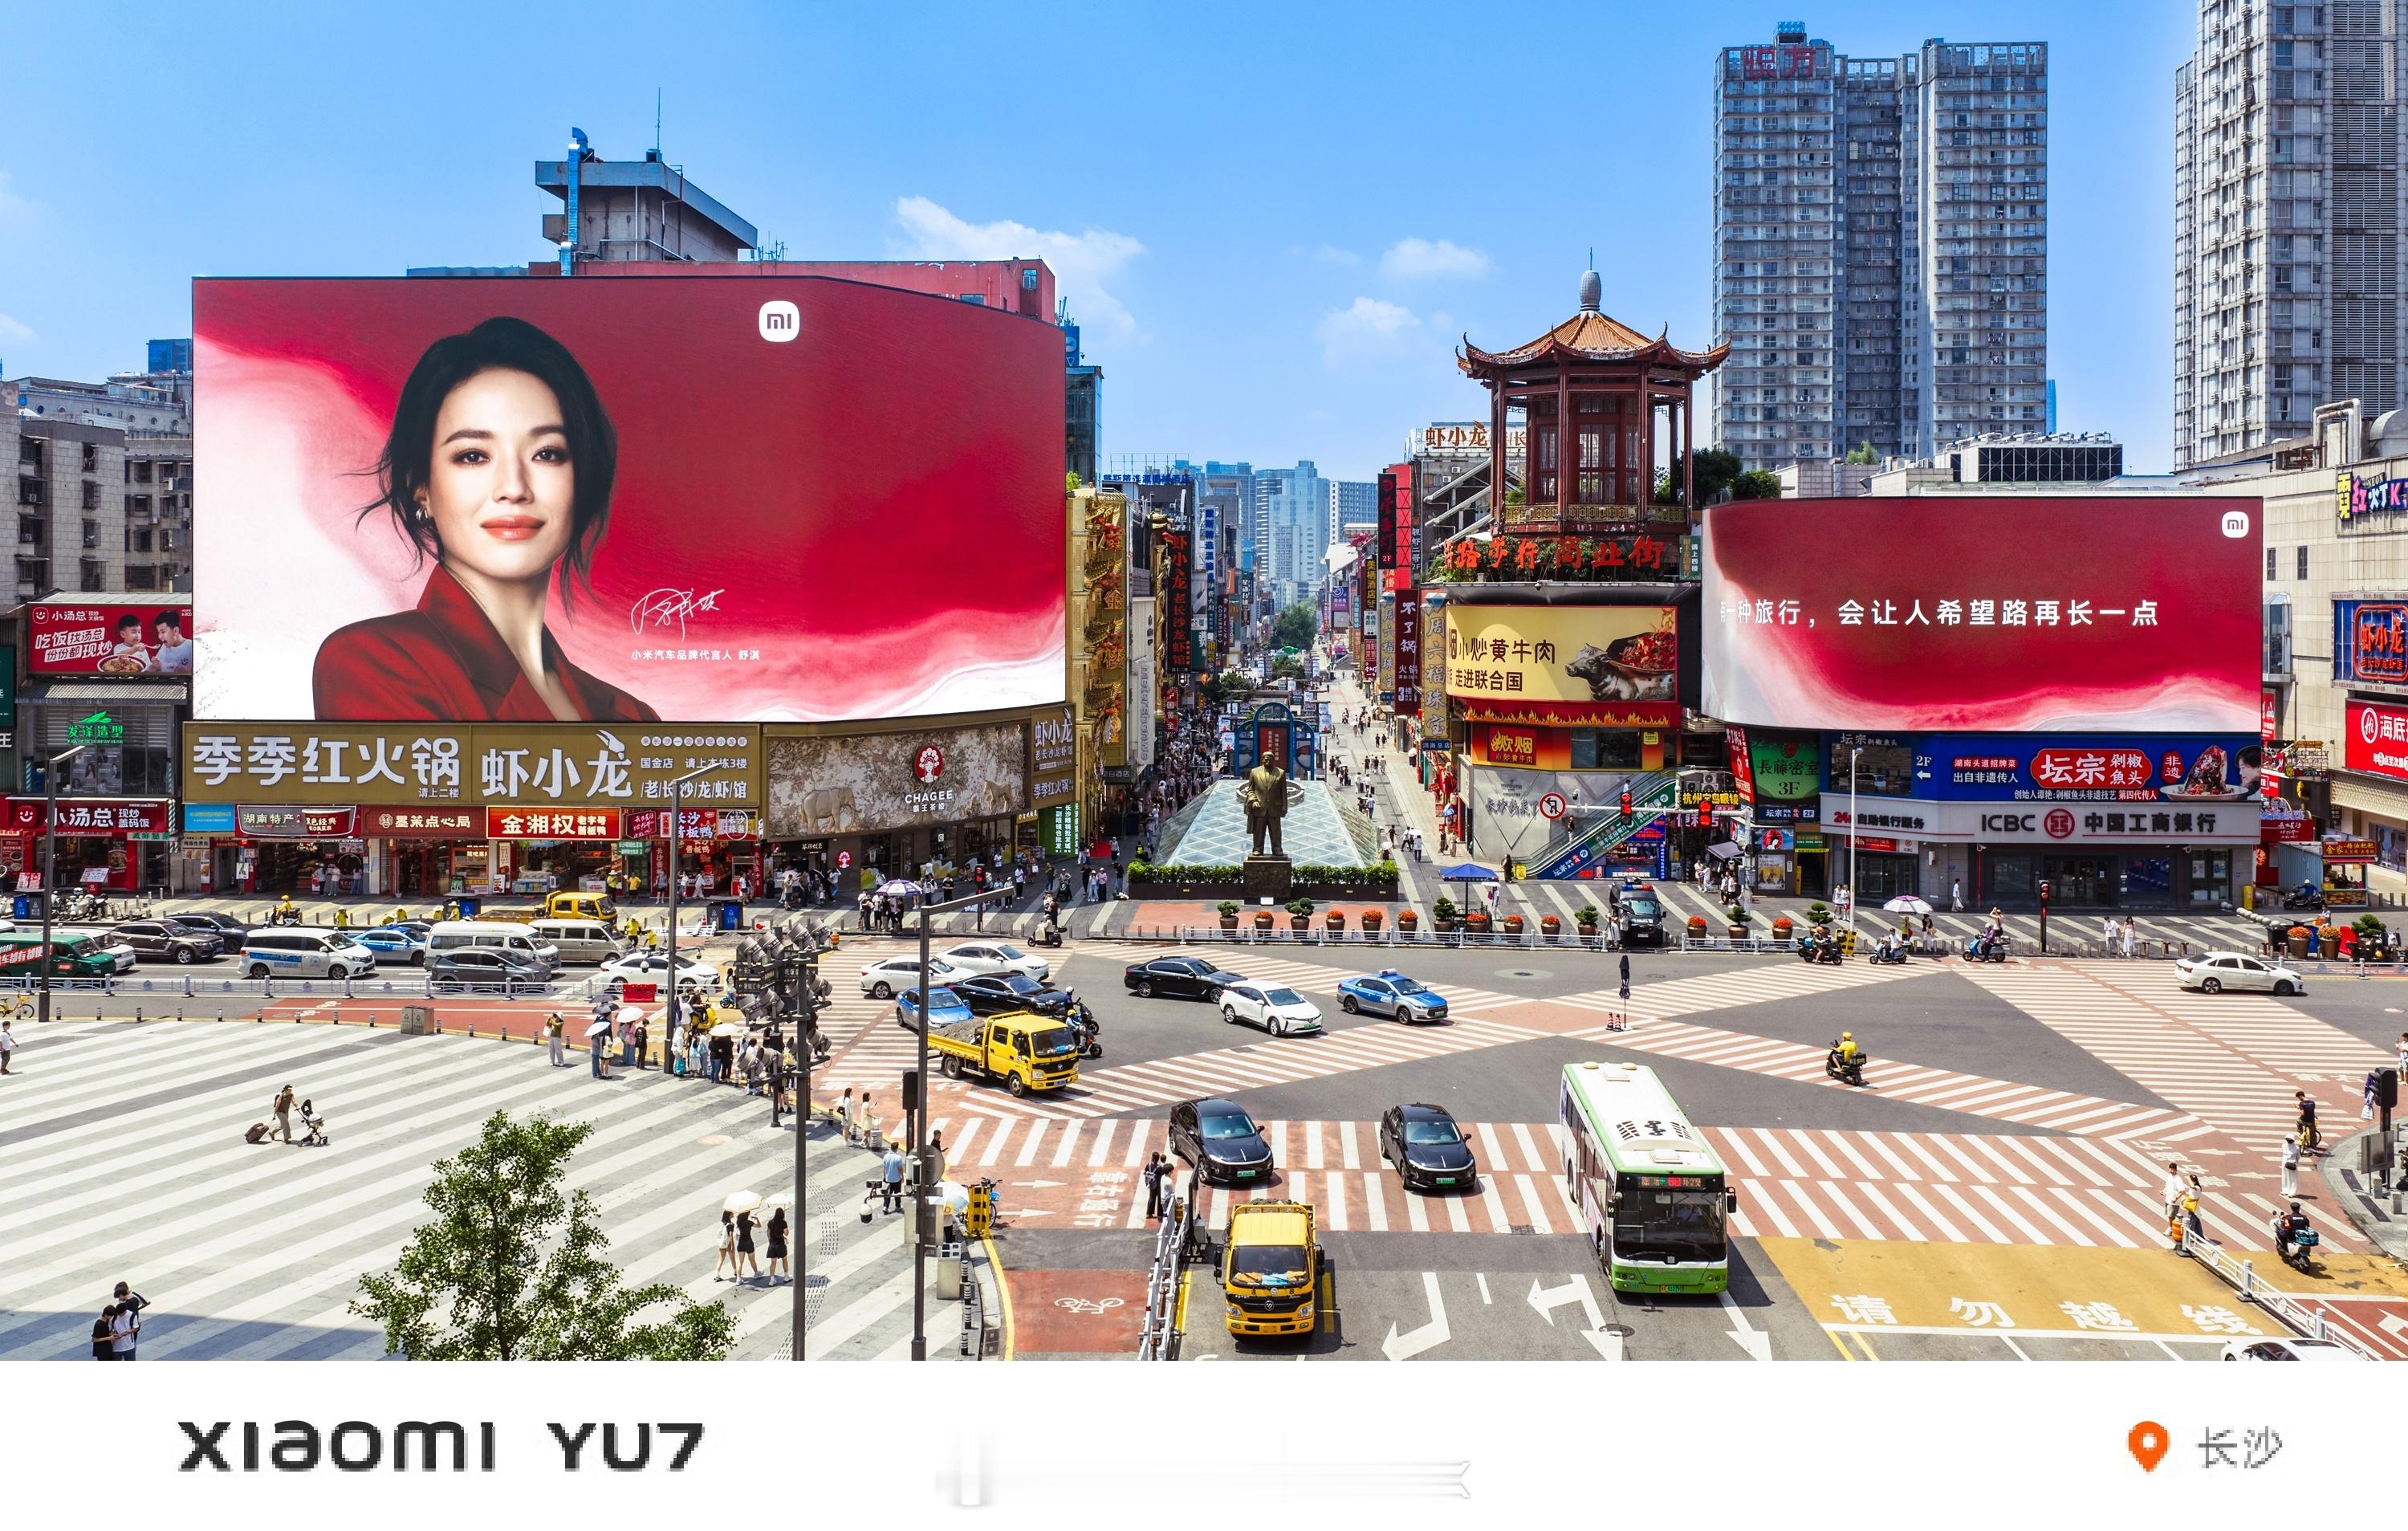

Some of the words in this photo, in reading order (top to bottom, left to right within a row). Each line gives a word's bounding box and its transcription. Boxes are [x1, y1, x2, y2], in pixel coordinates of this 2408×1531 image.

[1426, 420, 1487, 446] 虾小龙
[1171, 535, 1188, 589] 虾小龙
[52, 610, 87, 621] 小汤总
[1172, 592, 1186, 666] 老长沙龙虾馆
[1400, 601, 1417, 654] 不了锅
[2361, 613, 2404, 654] 虾小龙
[35, 627, 106, 649] 吃饭找汤总
[44, 639, 113, 663] 份份都现炒
[631, 649, 732, 662] 小米汽车品牌代言人
[738, 649, 761, 662] 舒淇
[1382, 608, 1395, 689] 周六福珠宝
[1398, 665, 1418, 675] 火锅
[1426, 617, 1446, 736] 周六福珠宝
[1455, 667, 1523, 692] 走进联合国
[67, 725, 124, 739] 发泽造型
[1035, 708, 1073, 747] 虾小龙
[2380, 715, 2408, 742] 海底
[641, 735, 748, 747] 来长沙一定要吃小龙虾
[1423, 742, 1450, 750] 湖南总店
[1841, 732, 1867, 745] 坛宗
[193, 735, 460, 787] 季季红火锅
[482, 730, 633, 800] 虾小龙
[641, 757, 673, 769] 国金店
[1496, 753, 1533, 763] 小炒黄牛肉
[1917, 755, 1932, 766] 2F
[1954, 758, 2016, 769] 湖南头道招牌菜
[2110, 753, 2143, 768] 剁椒
[1757, 759, 1820, 776] 長藤密室
[2040, 752, 2106, 789] 坛宗
[2164, 755, 2182, 779] 非遗
[1954, 772, 2019, 784] 出自非遗传人
[418, 787, 460, 799] 请上二楼
[905, 788, 954, 804] CHAGEE
[1034, 778, 1069, 800] 季季红火锅
[1779, 781, 1800, 796] 3F
[2119, 788, 2158, 800] 第四代传人
[1683, 792, 1739, 804] 杭州宝岛眼镜
[118, 808, 140, 818] 现炒
[912, 803, 946, 812] 霸王茶姬
[1766, 808, 1783, 817] 坛宗
[118, 817, 150, 829] 盖码饭
[243, 812, 295, 825] 湖南特产
[395, 815, 471, 829] 墨茉点心局
[501, 813, 576, 835] 金湘权
[577, 816, 607, 826] 老字号
[729, 816, 746, 825] 长沙
[1857, 813, 1925, 829] 自助银行服务
[1981, 814, 2036, 832] ICBC
[2085, 812, 2216, 833] 中国工商银行
[577, 825, 607, 836] 酱板鸭
[1831, 1293, 2264, 1337] 请勿越线
